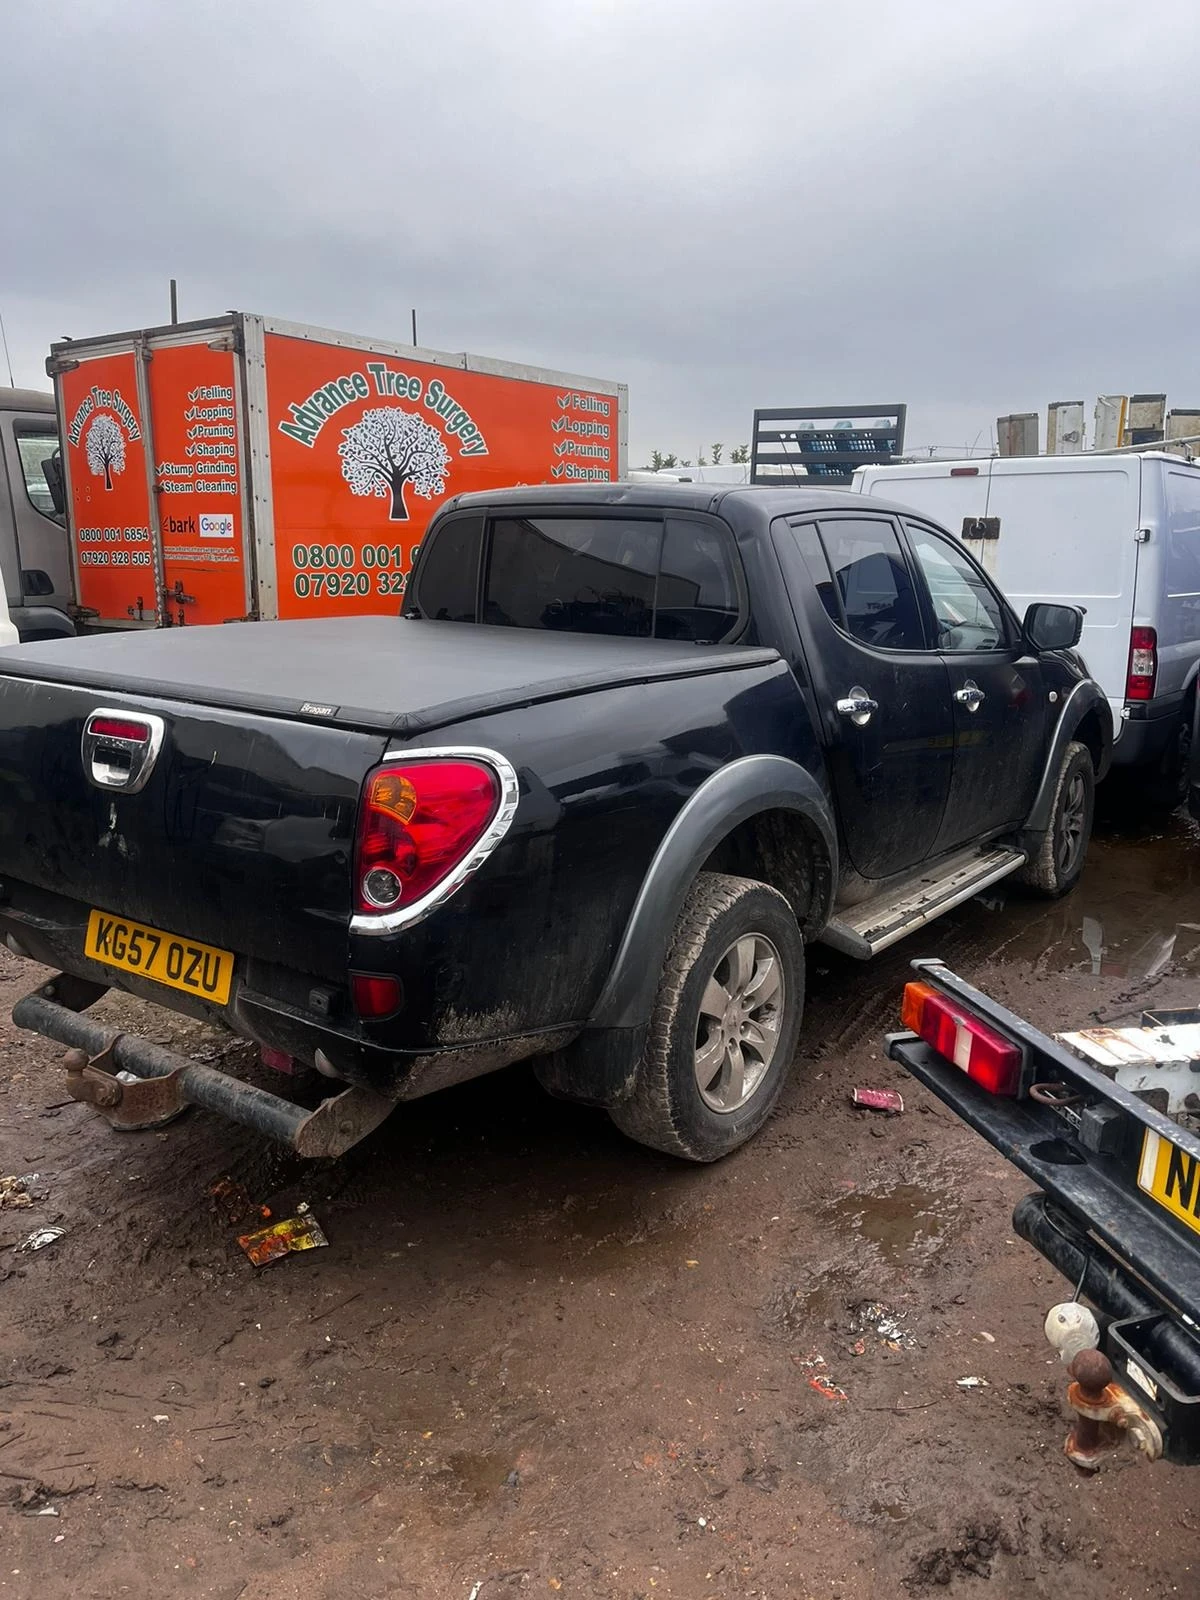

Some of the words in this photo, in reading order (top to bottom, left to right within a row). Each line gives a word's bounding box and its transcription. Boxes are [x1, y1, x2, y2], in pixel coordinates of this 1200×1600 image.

[200, 385, 233, 400] Felling
[68, 395, 94, 447] Advance
[91, 385, 112, 408] Tree
[112, 389, 141, 441] Surgery
[195, 404, 234, 421] Lopping
[278, 372, 370, 449] Advance
[366, 362, 422, 401] Tree
[424, 379, 489, 457] Surgery
[572, 394, 610, 417] Felling
[197, 424, 235, 438] Pruning
[565, 416, 610, 439] Lopping
[196, 442, 236, 458] Shaping
[566, 440, 610, 462] Pruning
[164, 462, 194, 477] Stump
[196, 460, 236, 476] Grinding
[565, 461, 610, 482] Shaping
[164, 481, 193, 493] Steam
[196, 480, 237, 495] Cleaning
[79, 528, 102, 542] 0800
[104, 527, 121, 542] 001
[124, 527, 149, 542] 6854
[169, 516, 196, 533] bark
[201, 517, 232, 535] Google
[81, 551, 109, 565] 07920
[112, 551, 130, 565] 328
[132, 551, 151, 565] 505
[292, 544, 355, 569] 0800
[361, 544, 402, 569] 001
[294, 572, 371, 598] 07920
[95, 918, 162, 971] KG57
[166, 942, 222, 993] OZU
[1165, 1144, 1200, 1219] N
